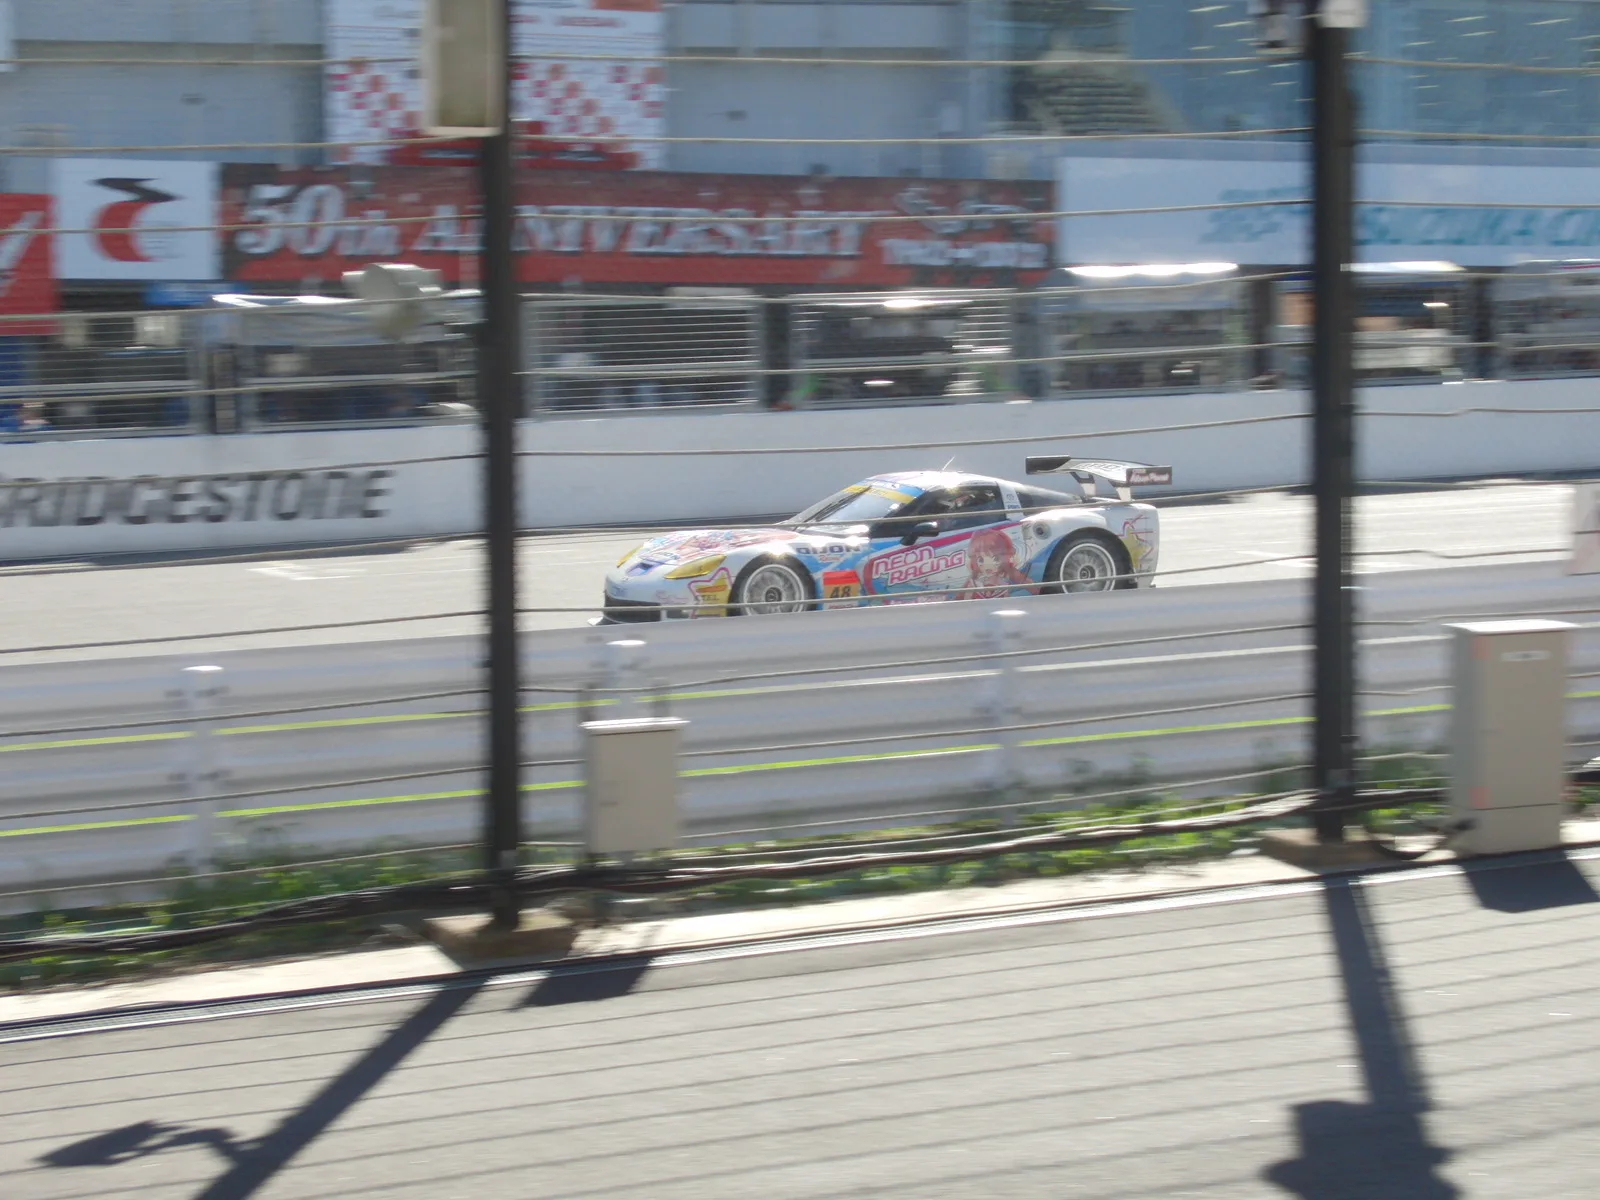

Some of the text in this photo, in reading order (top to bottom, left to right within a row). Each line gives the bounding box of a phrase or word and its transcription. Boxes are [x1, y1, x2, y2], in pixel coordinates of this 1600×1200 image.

[235, 184, 402, 256] 50th
[0, 470, 395, 528] RIDGESTONE
[873, 546, 934, 578] NEON
[888, 551, 965, 585] RACING
[829, 585, 852, 599] 48
